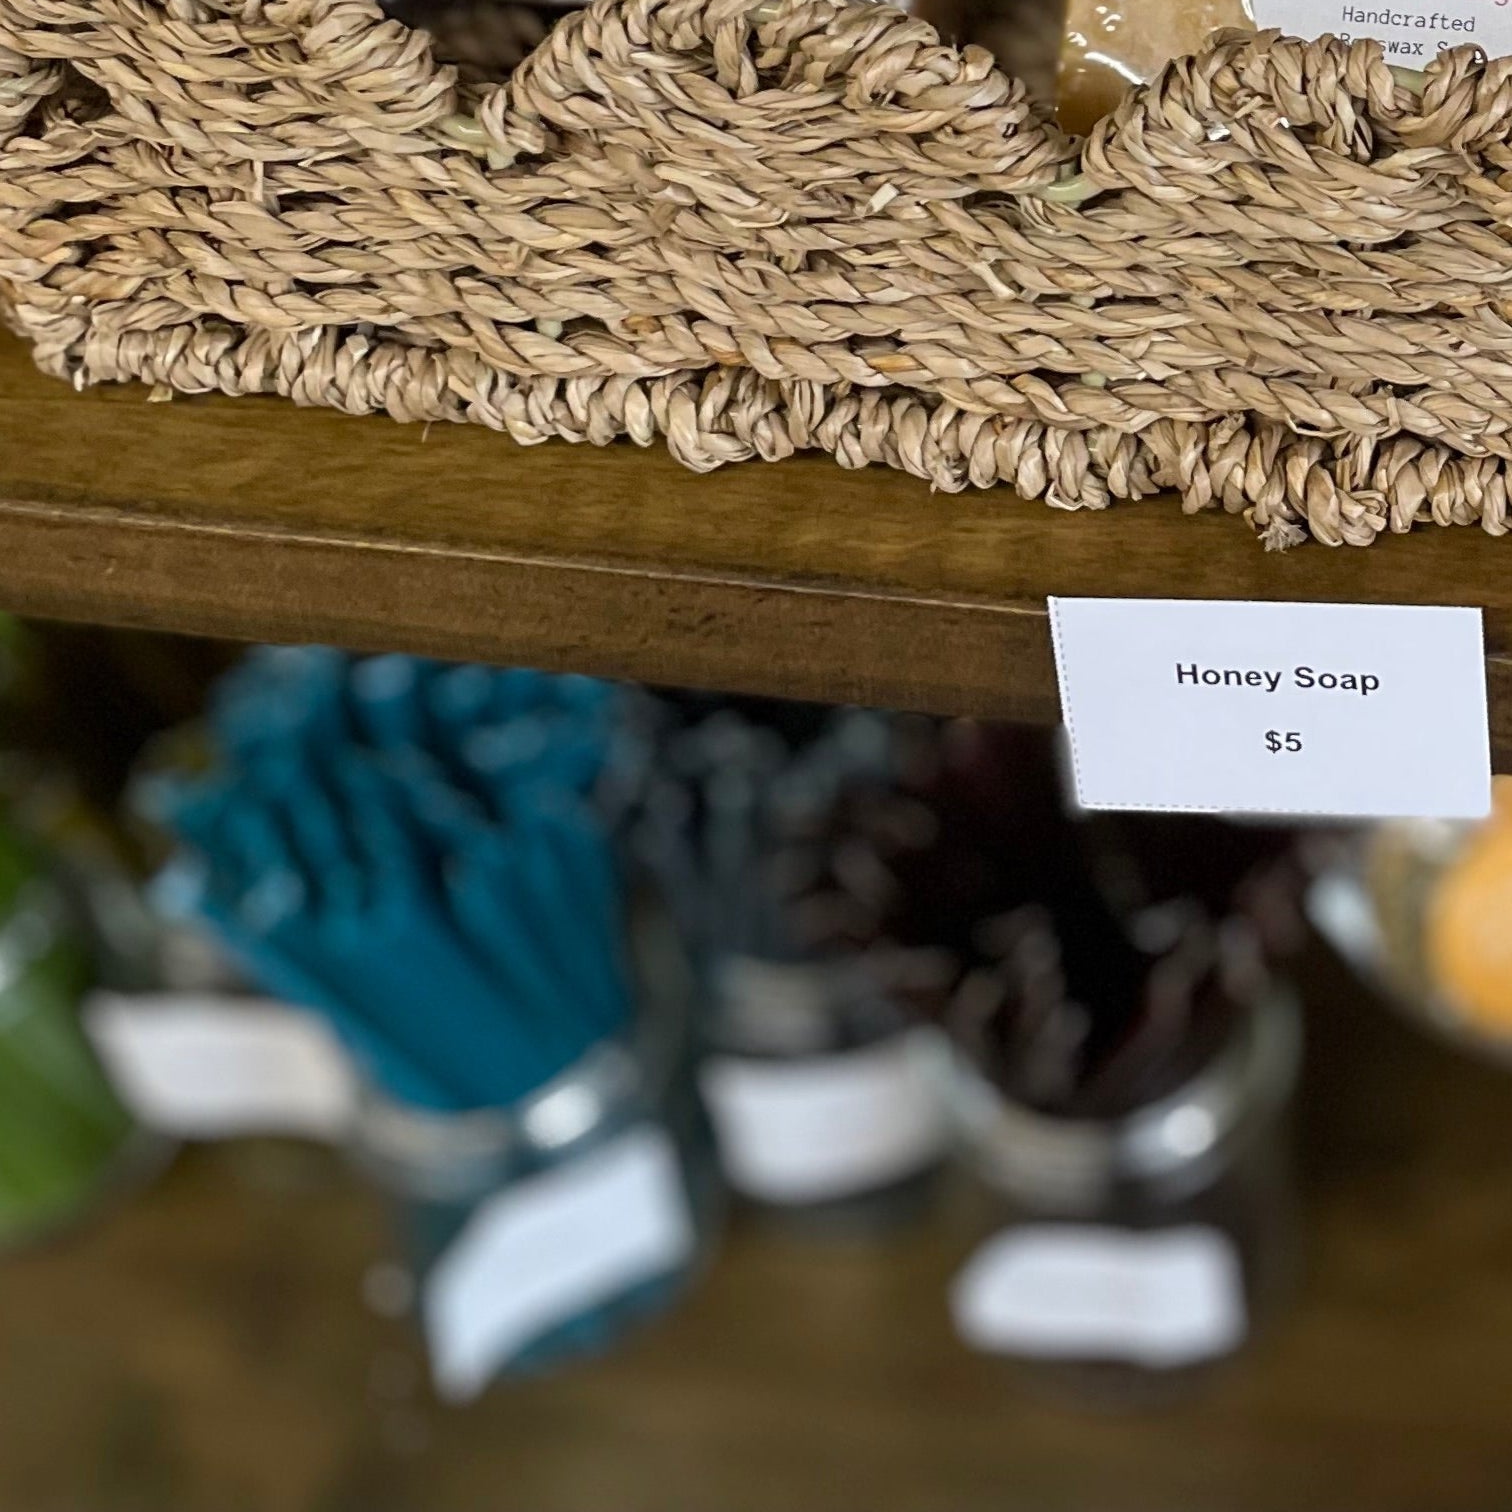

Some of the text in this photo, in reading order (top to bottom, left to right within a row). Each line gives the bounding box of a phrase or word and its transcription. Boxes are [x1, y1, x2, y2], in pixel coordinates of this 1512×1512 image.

[1342, 5, 1476, 33] Handcrafted
[1340, 32, 1424, 56] Bswax
[1175, 662, 1380, 696] Honey Soap
[1265, 729, 1303, 754] $5
